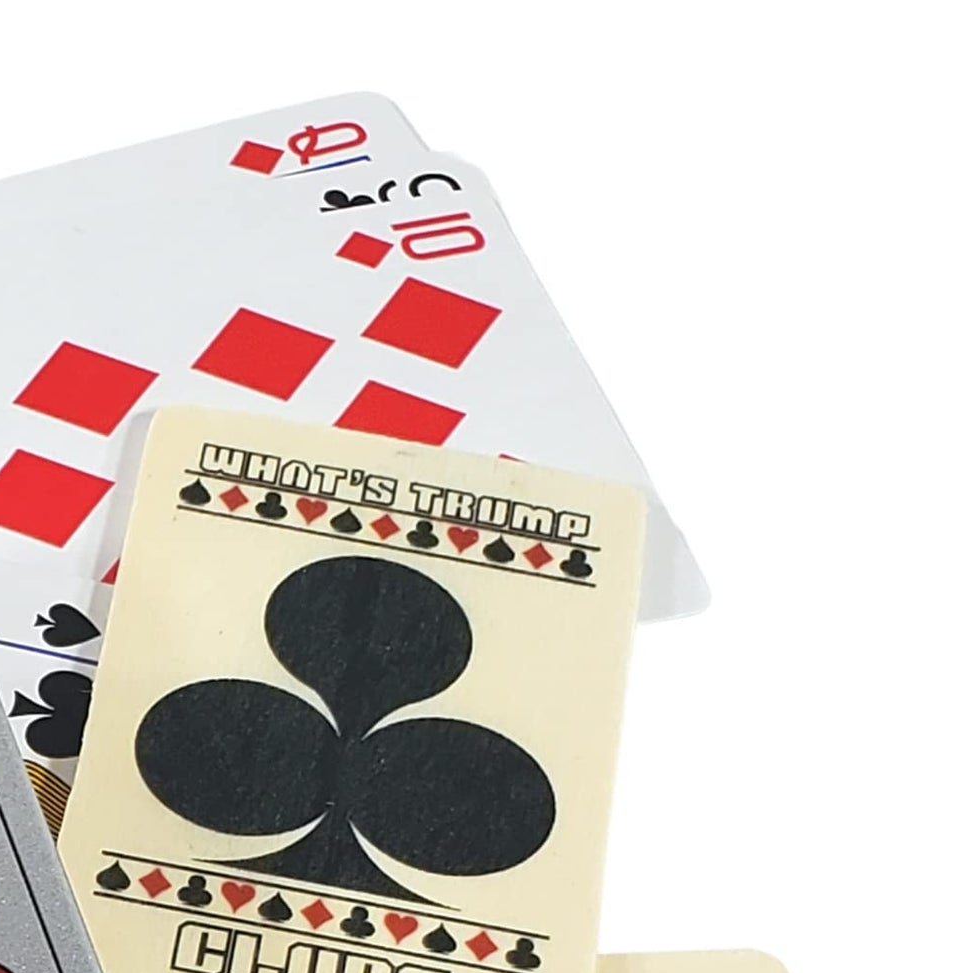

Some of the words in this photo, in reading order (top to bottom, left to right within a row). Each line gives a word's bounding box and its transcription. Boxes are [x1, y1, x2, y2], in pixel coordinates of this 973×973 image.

[287, 121, 368, 166] Q
[390, 212, 486, 261] 10
[199, 443, 397, 505] WHAT'S
[409, 482, 591, 540] TRUMP
